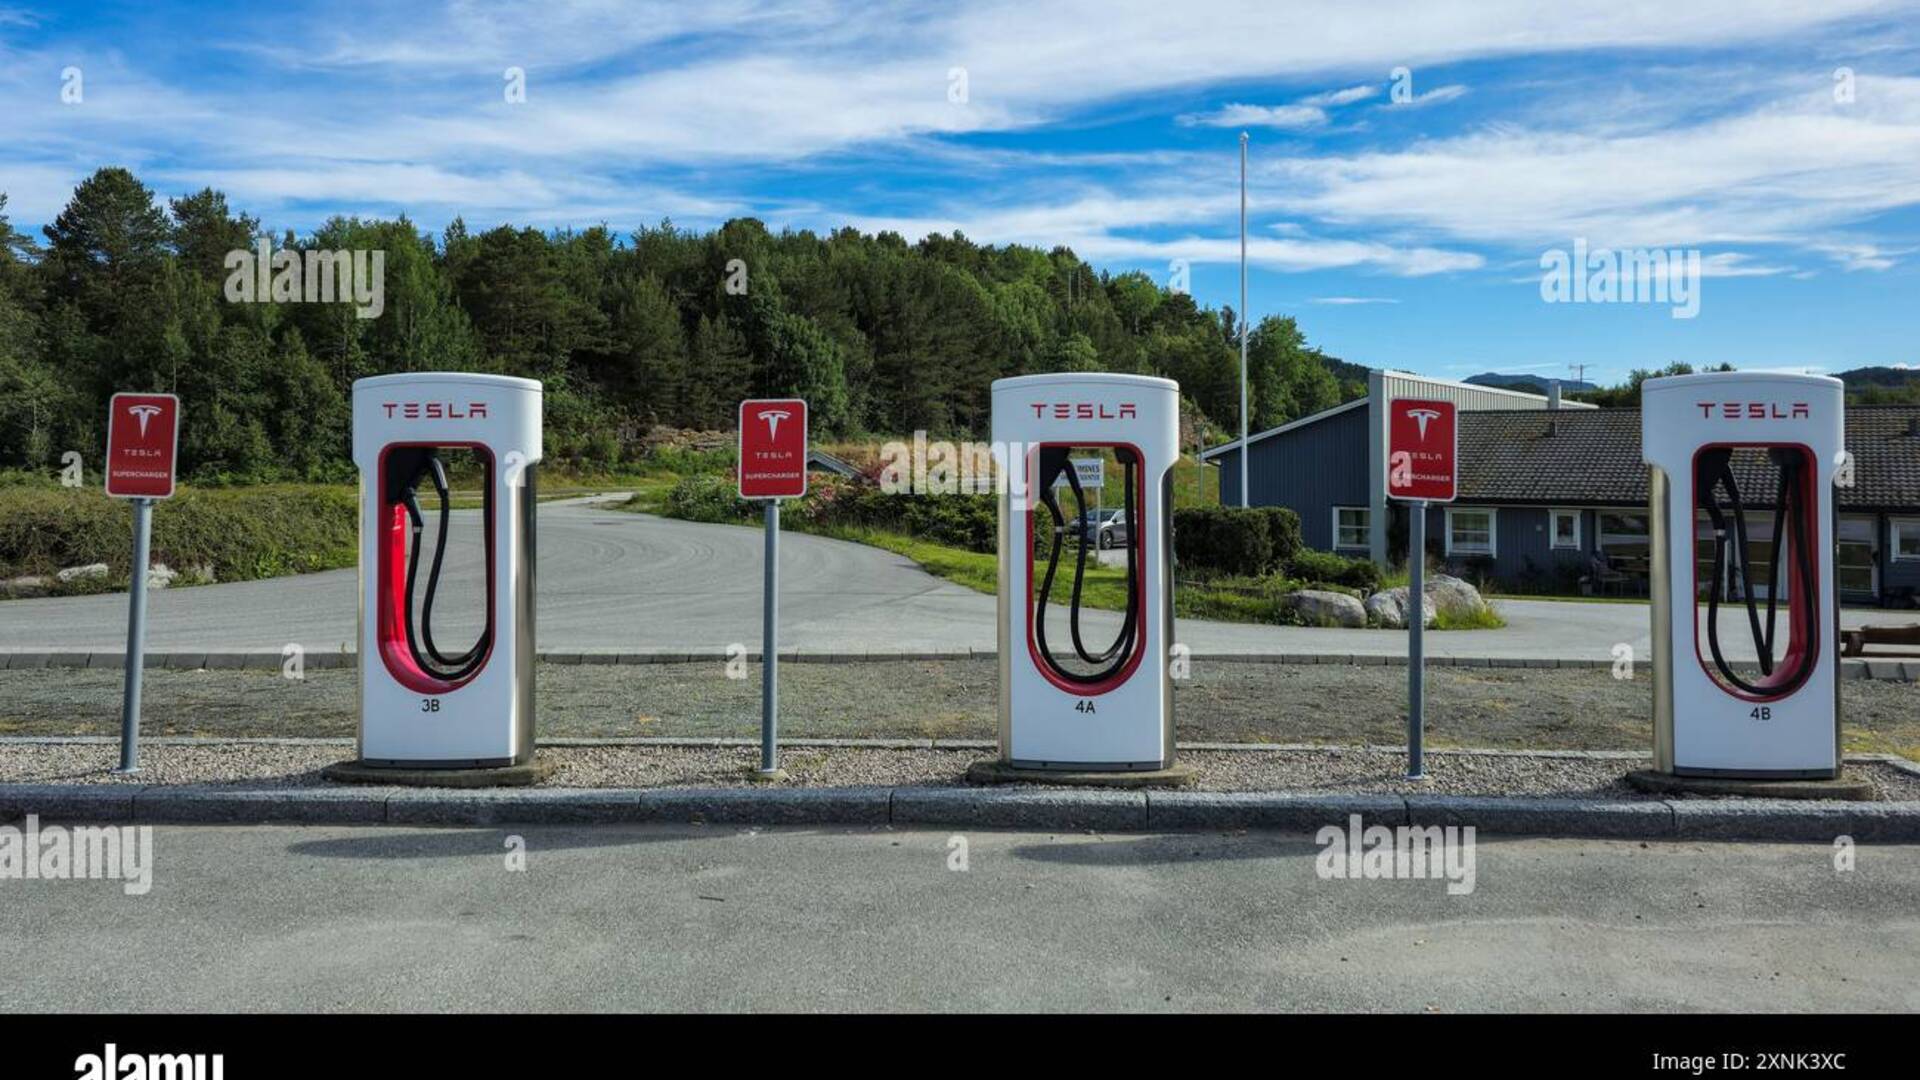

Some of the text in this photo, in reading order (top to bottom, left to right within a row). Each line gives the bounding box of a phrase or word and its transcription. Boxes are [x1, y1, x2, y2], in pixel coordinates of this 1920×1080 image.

[382, 403, 487, 419] TESLA
[1030, 403, 1136, 419] TESLA
[1697, 403, 1809, 419] TESLA
[123, 449, 161, 457] TESLA
[755, 452, 793, 460] TESLA
[112, 470, 169, 479] SUPERCHARGER
[745, 472, 801, 480] SUPERCHARGER
[422, 699, 440, 712] 3B
[1075, 700, 1096, 714] 4A
[1750, 707, 1771, 720] 4B
